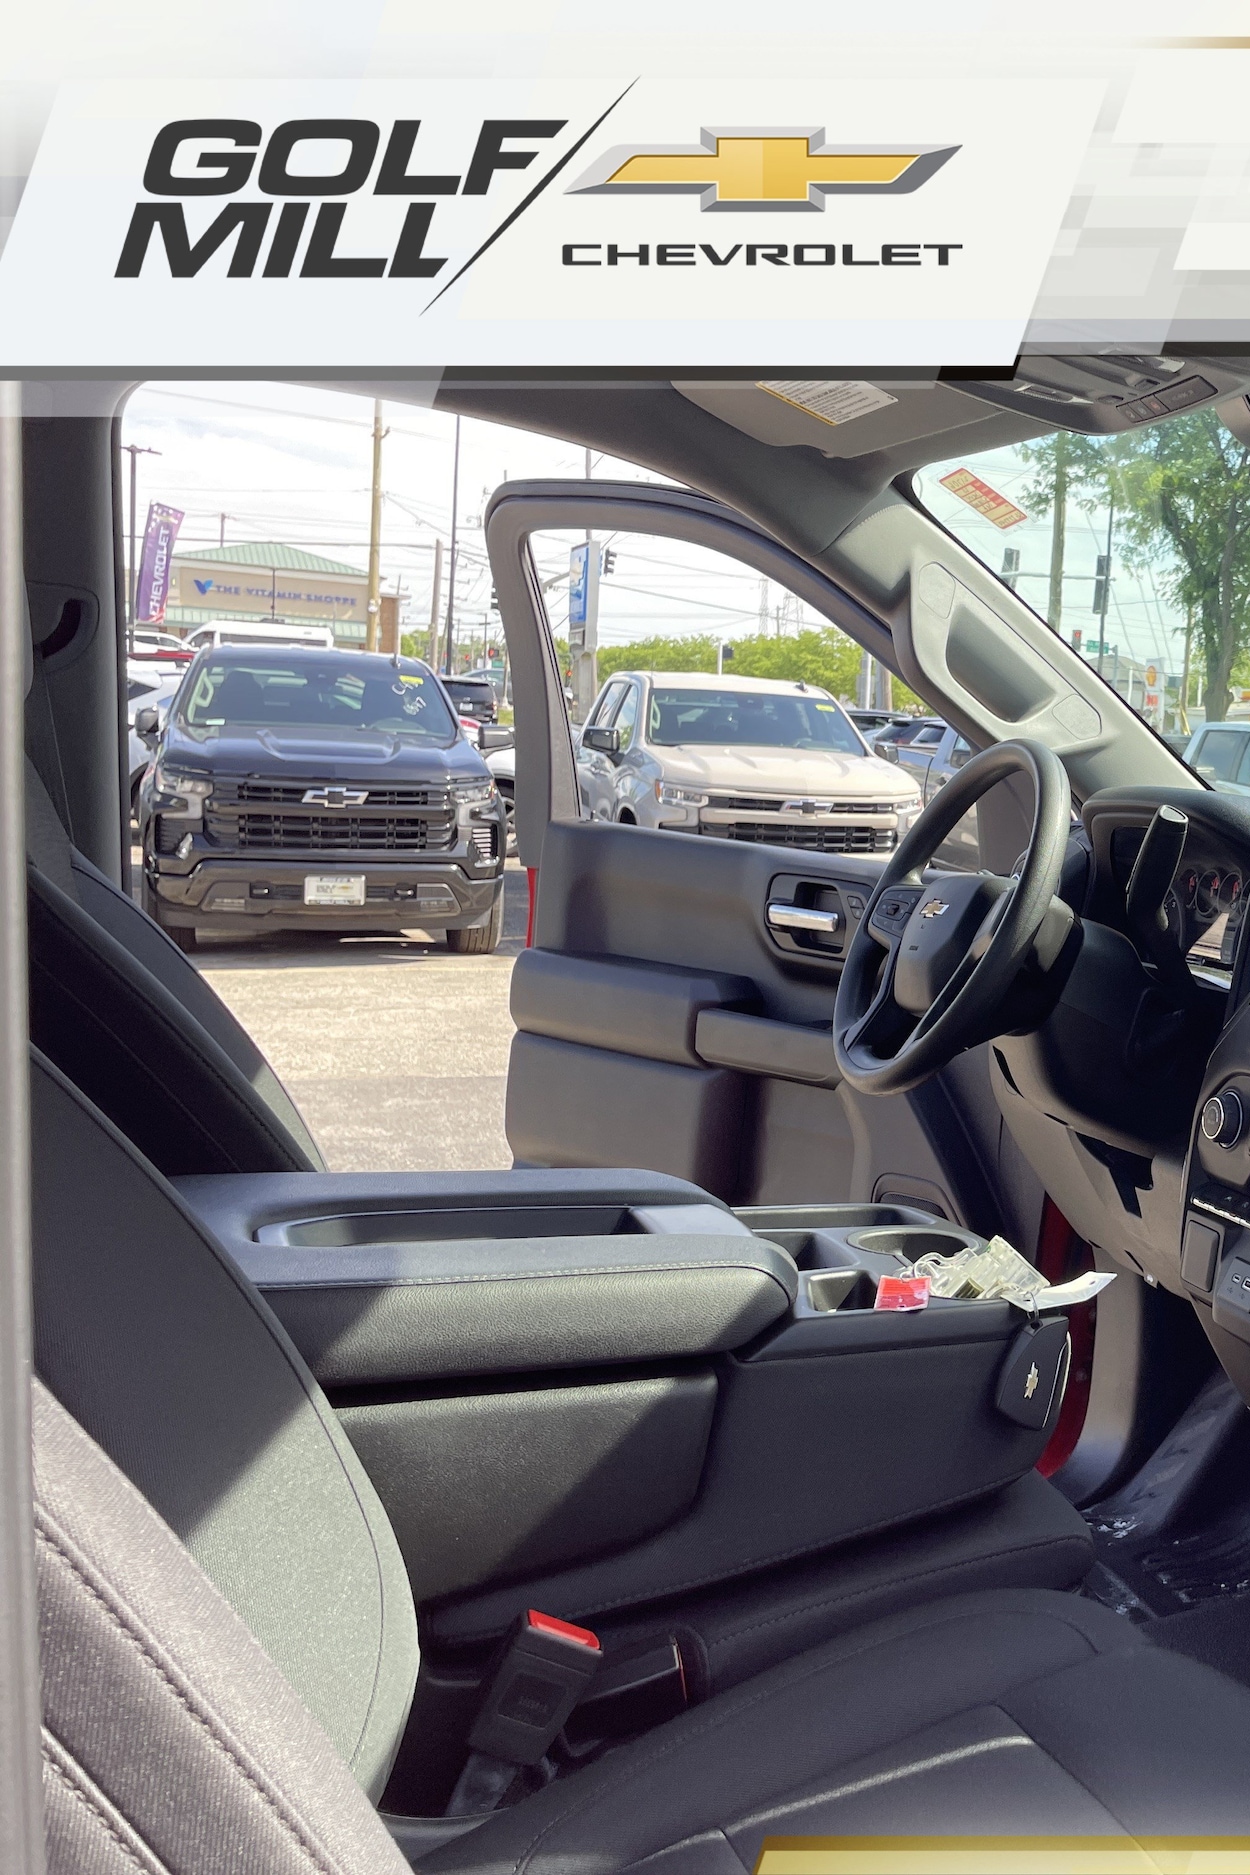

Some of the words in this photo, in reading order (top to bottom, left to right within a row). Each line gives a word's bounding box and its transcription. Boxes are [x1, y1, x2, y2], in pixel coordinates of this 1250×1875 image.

[148, 526, 170, 616] CHEVROLET
[215, 584, 241, 596] THE
[246, 586, 302, 602] VITAMIN
[306, 593, 357, 607] SHOPPE
